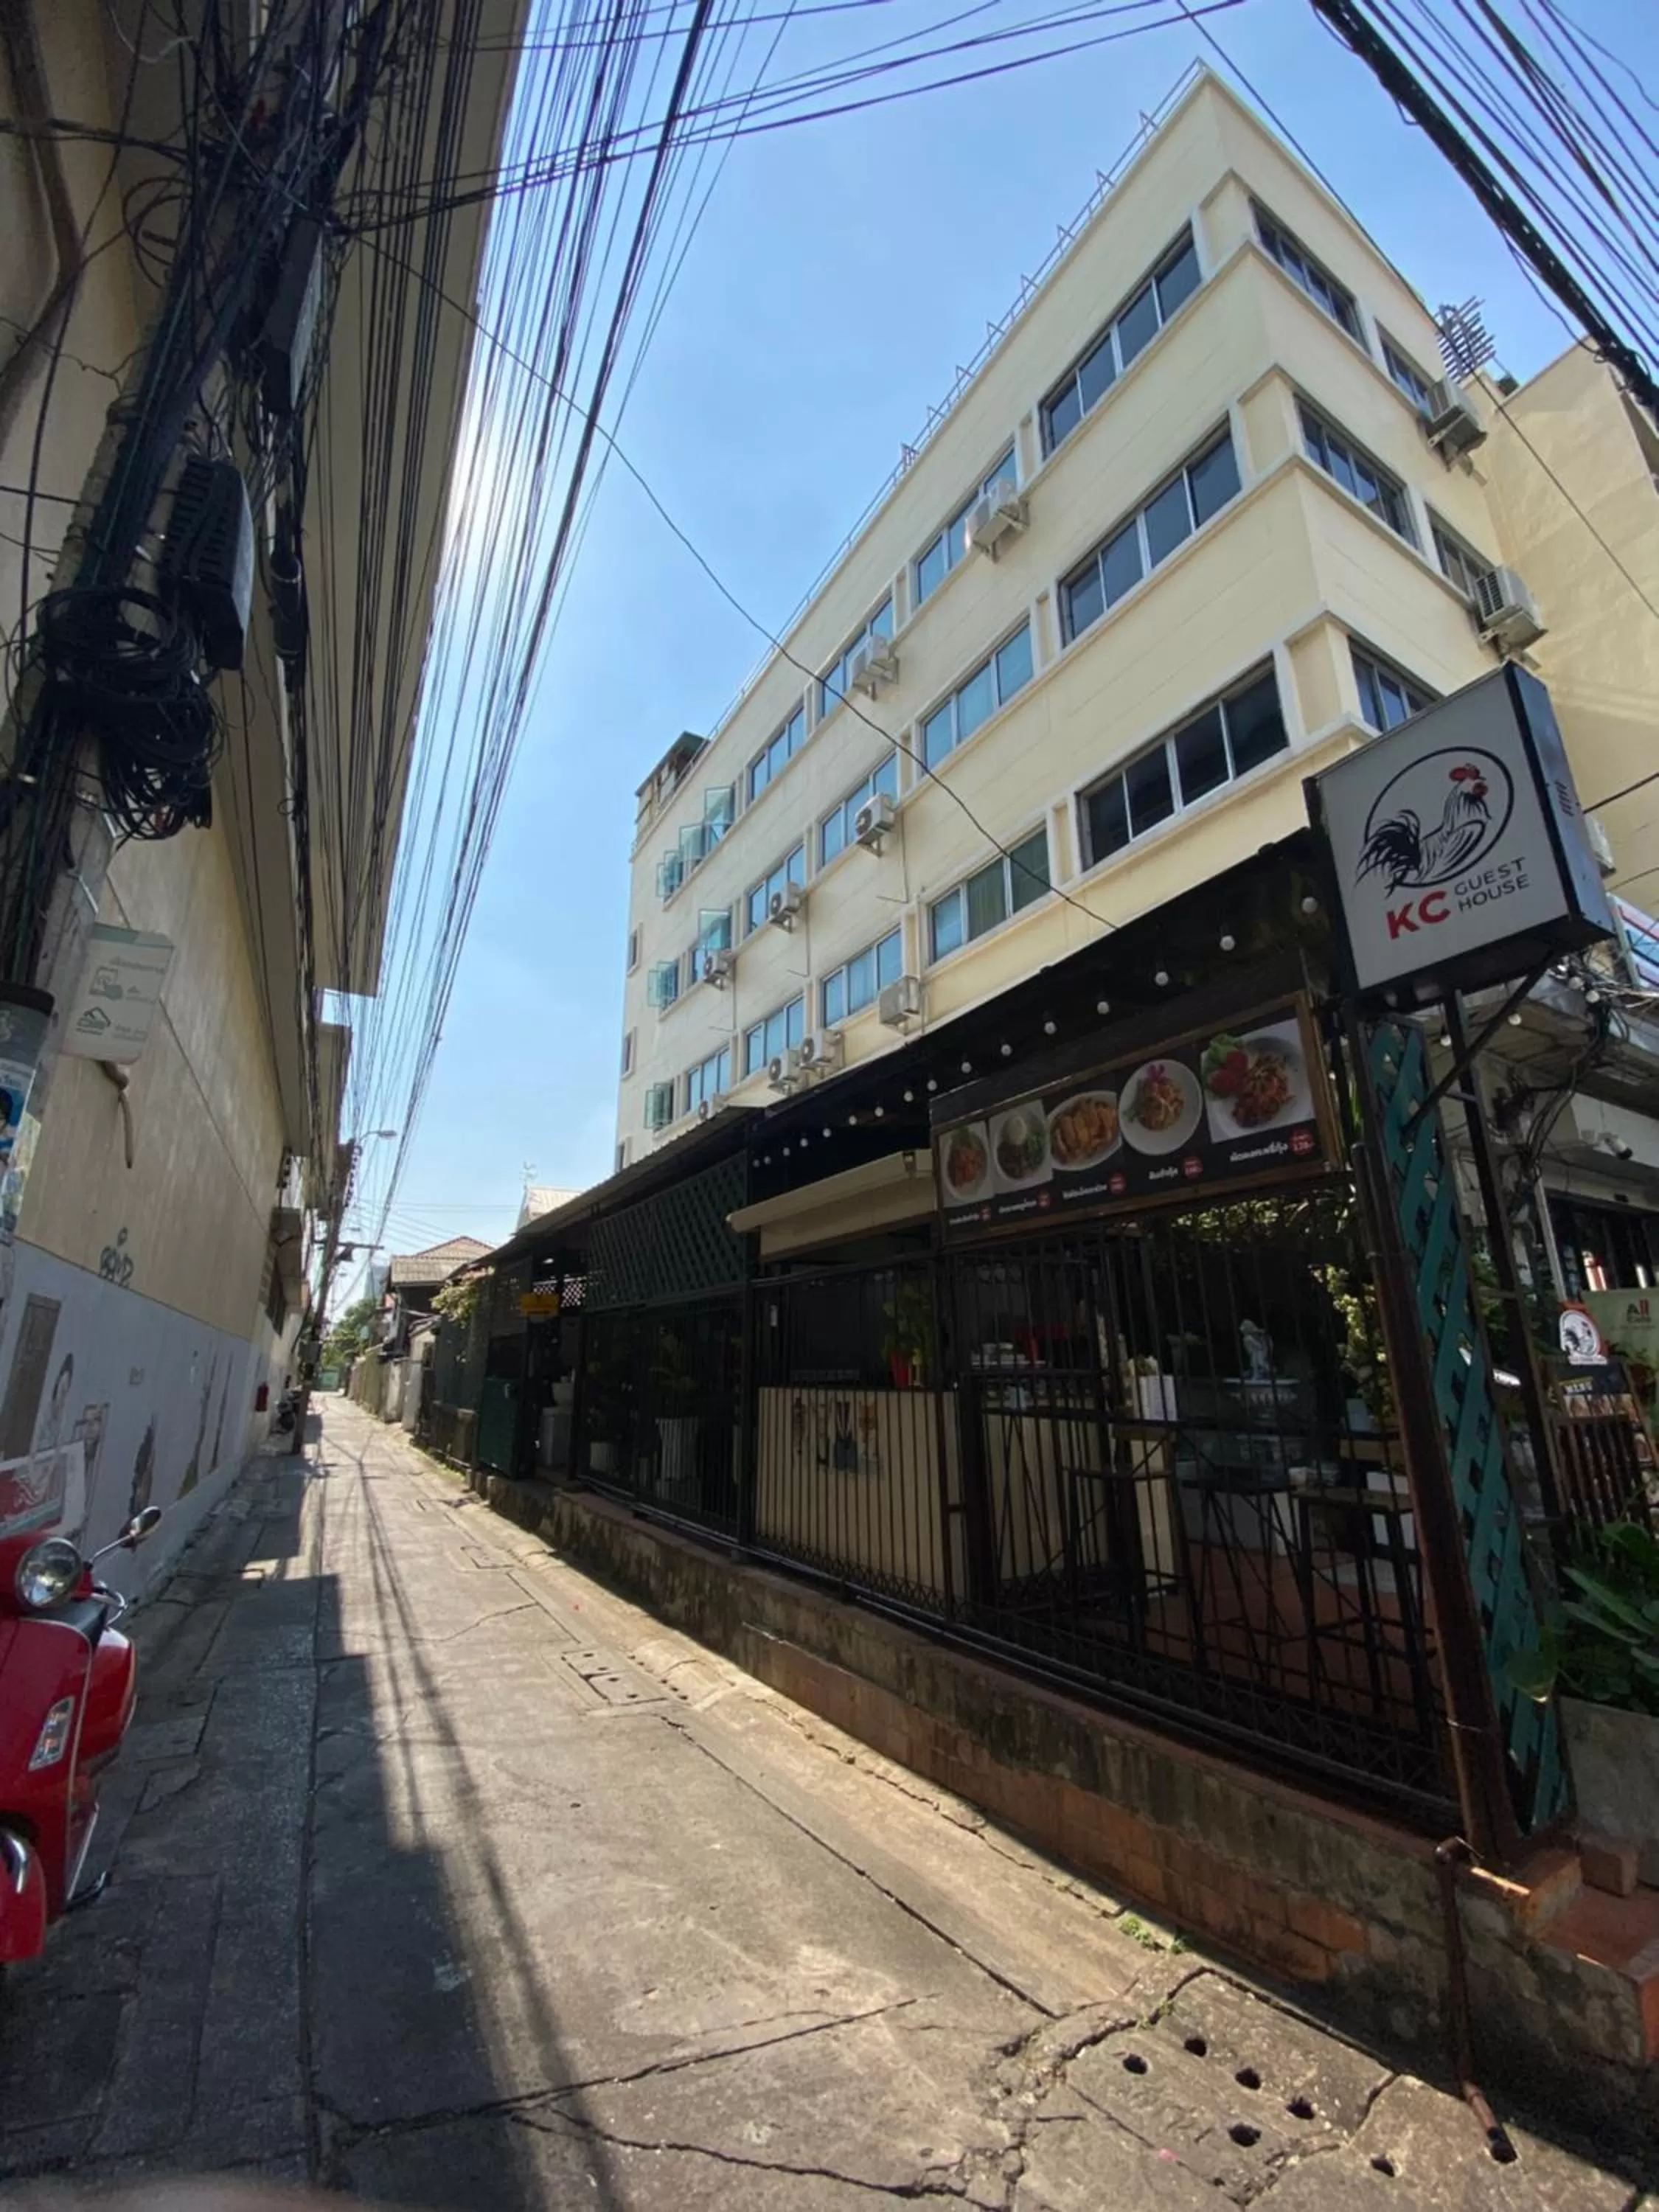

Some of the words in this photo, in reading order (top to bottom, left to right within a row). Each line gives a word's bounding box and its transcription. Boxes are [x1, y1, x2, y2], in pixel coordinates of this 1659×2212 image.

[1454, 856, 1526, 896] GUEST
[1458, 873, 1529, 911] HOUSE
[1386, 890, 1451, 940] KC
